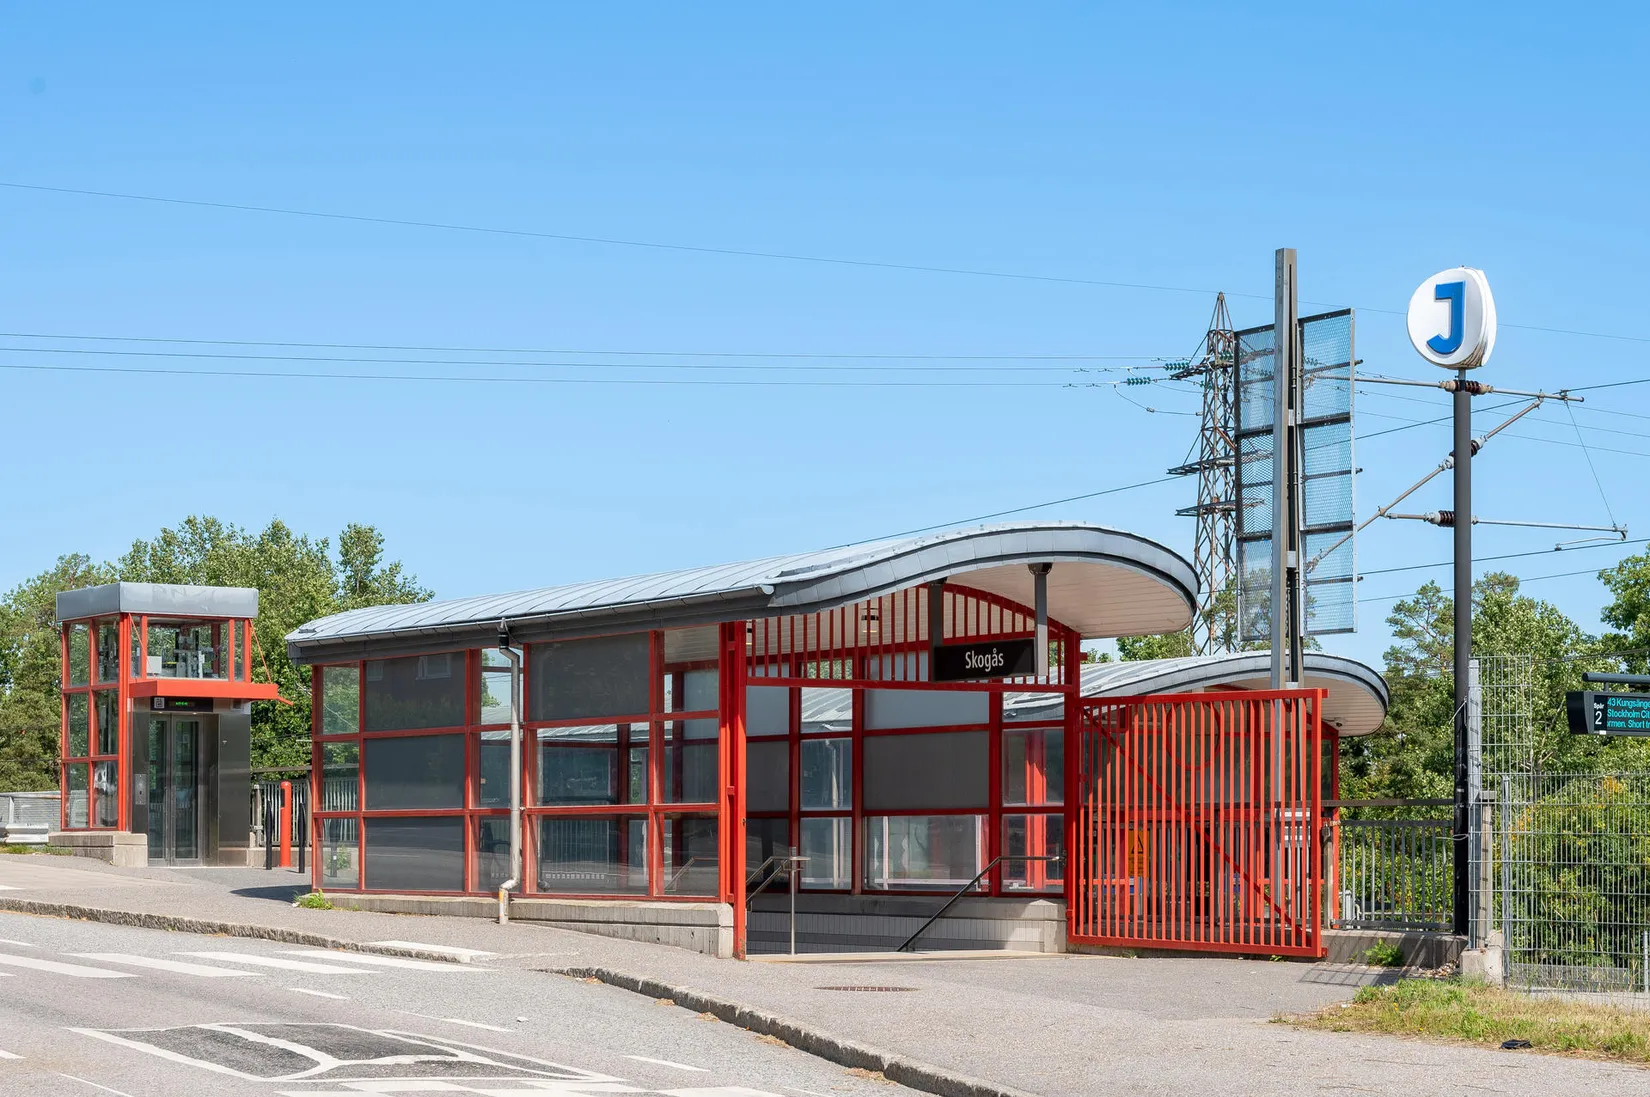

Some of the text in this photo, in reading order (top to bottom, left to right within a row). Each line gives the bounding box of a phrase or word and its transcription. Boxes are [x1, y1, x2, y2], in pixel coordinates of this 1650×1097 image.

[1427, 280, 1466, 354] J
[965, 648, 1004, 672] Skogås
[1607, 698, 1615, 706] 43
[1595, 711, 1602, 725] 2
[1607, 709, 1640, 718] Stockholm
[1628, 720, 1645, 728] Short
